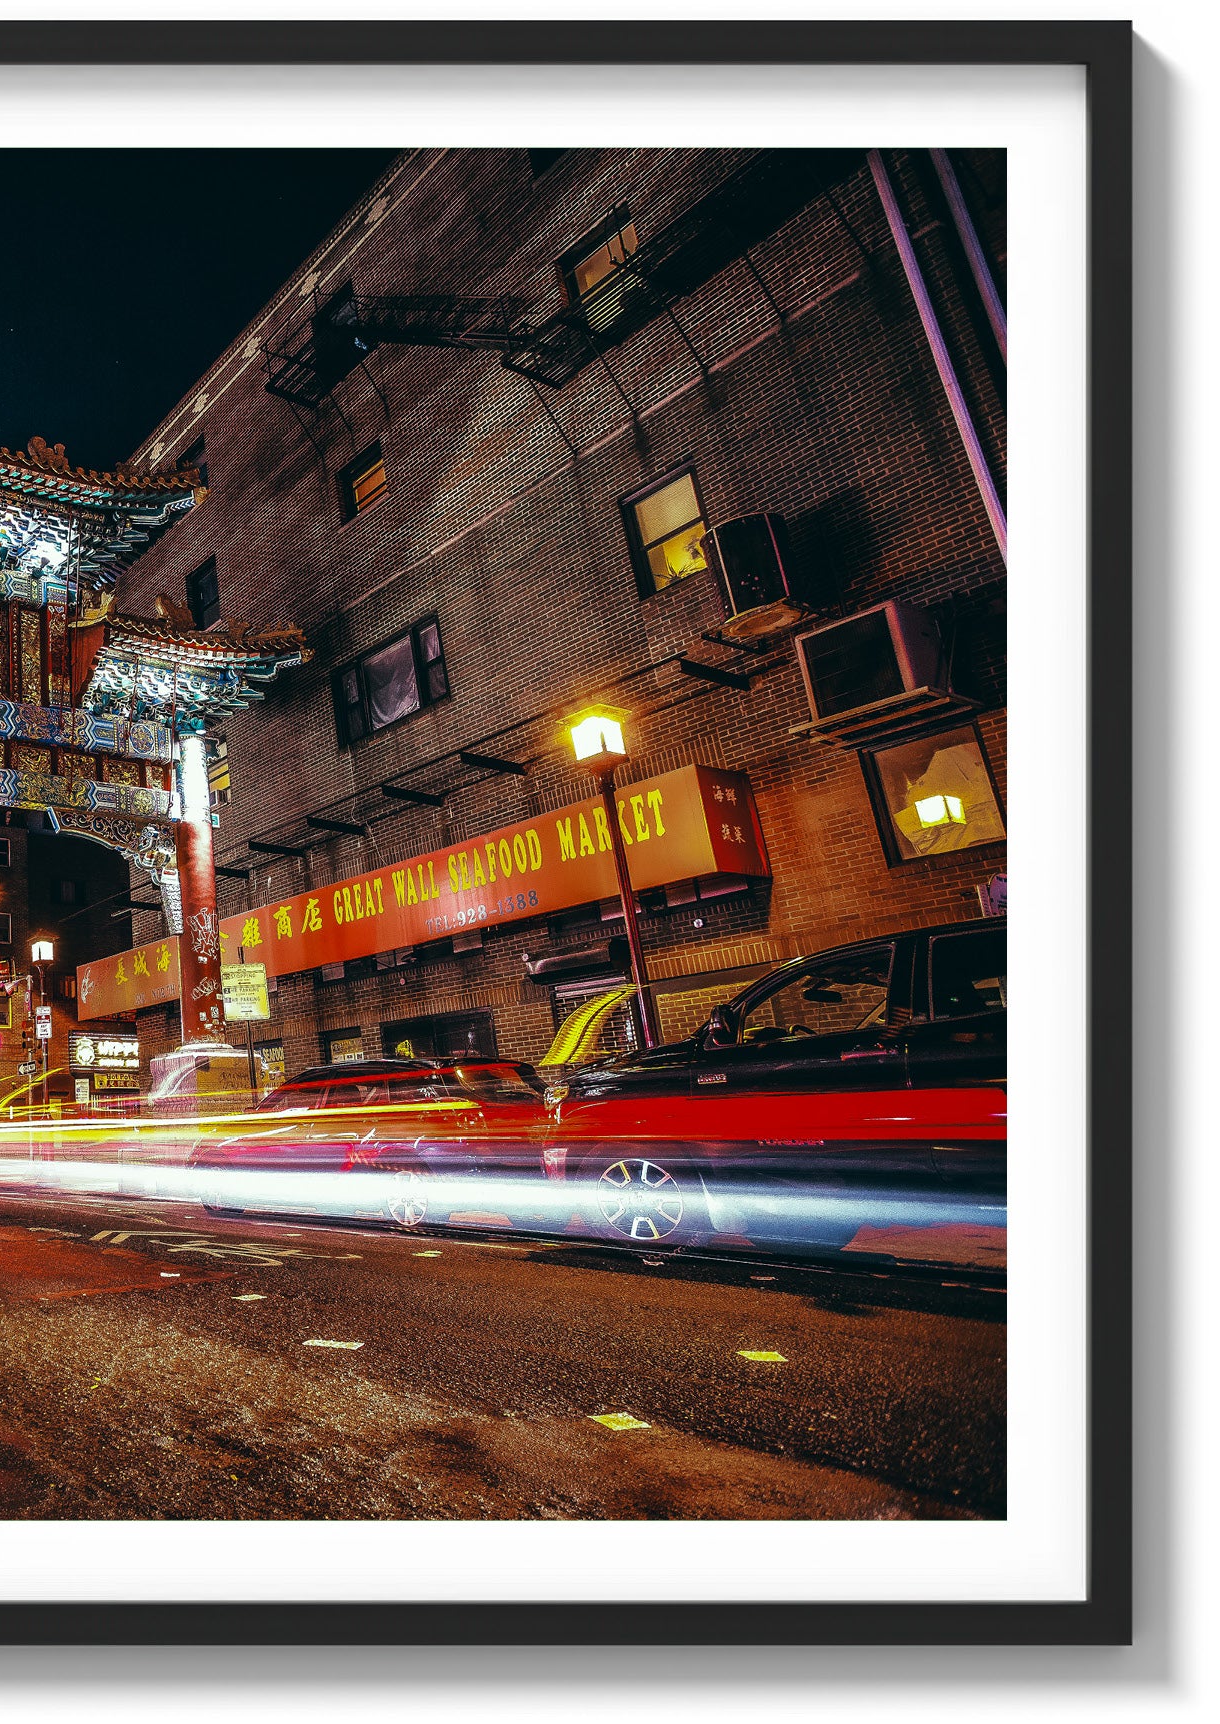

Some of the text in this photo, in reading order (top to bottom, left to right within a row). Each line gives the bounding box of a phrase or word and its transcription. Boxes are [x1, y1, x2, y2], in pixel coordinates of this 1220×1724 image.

[333, 788, 667, 926] GREAT WALL SEAFOOD MARKET
[425, 888, 540, 936] TEL:928-1388
